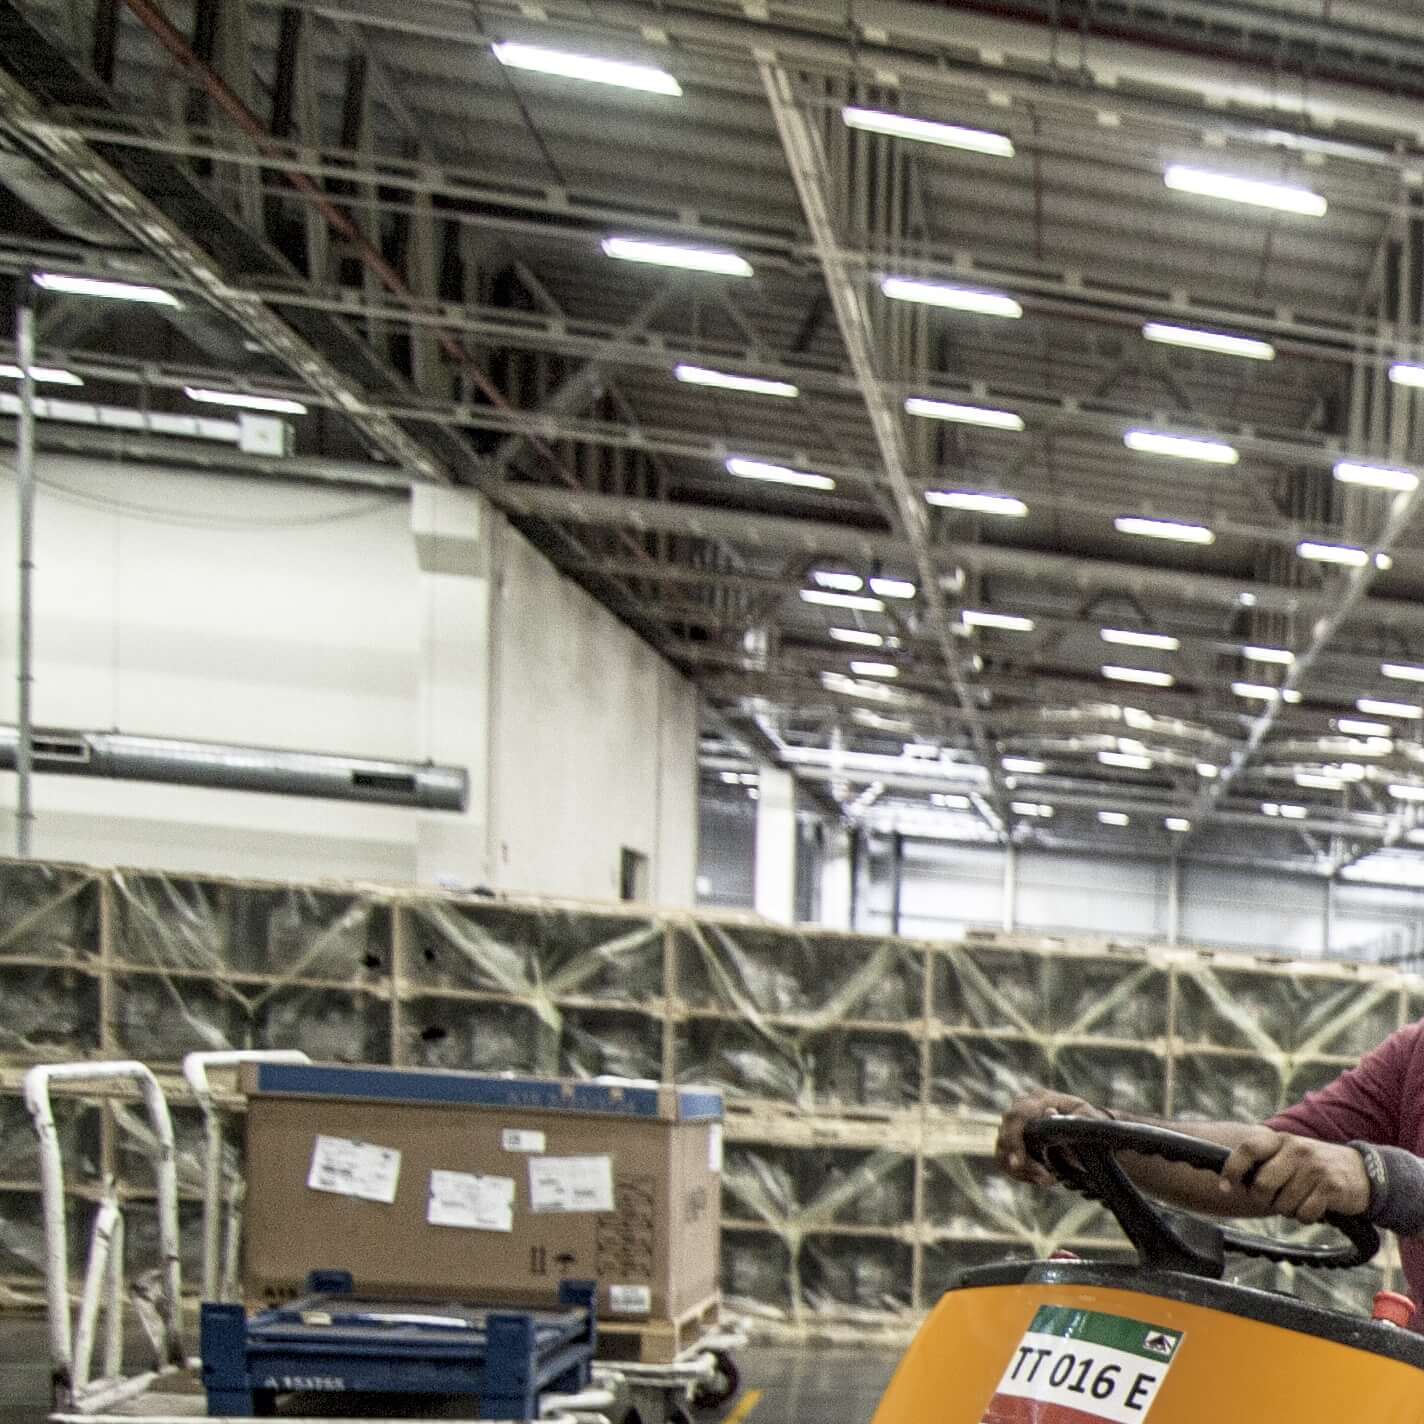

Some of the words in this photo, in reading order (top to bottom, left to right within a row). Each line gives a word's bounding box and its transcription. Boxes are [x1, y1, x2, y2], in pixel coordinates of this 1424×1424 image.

[1011, 1346, 1052, 1383] TT
[1048, 1353, 1122, 1400] 016
[1123, 1372, 1157, 1411] E
